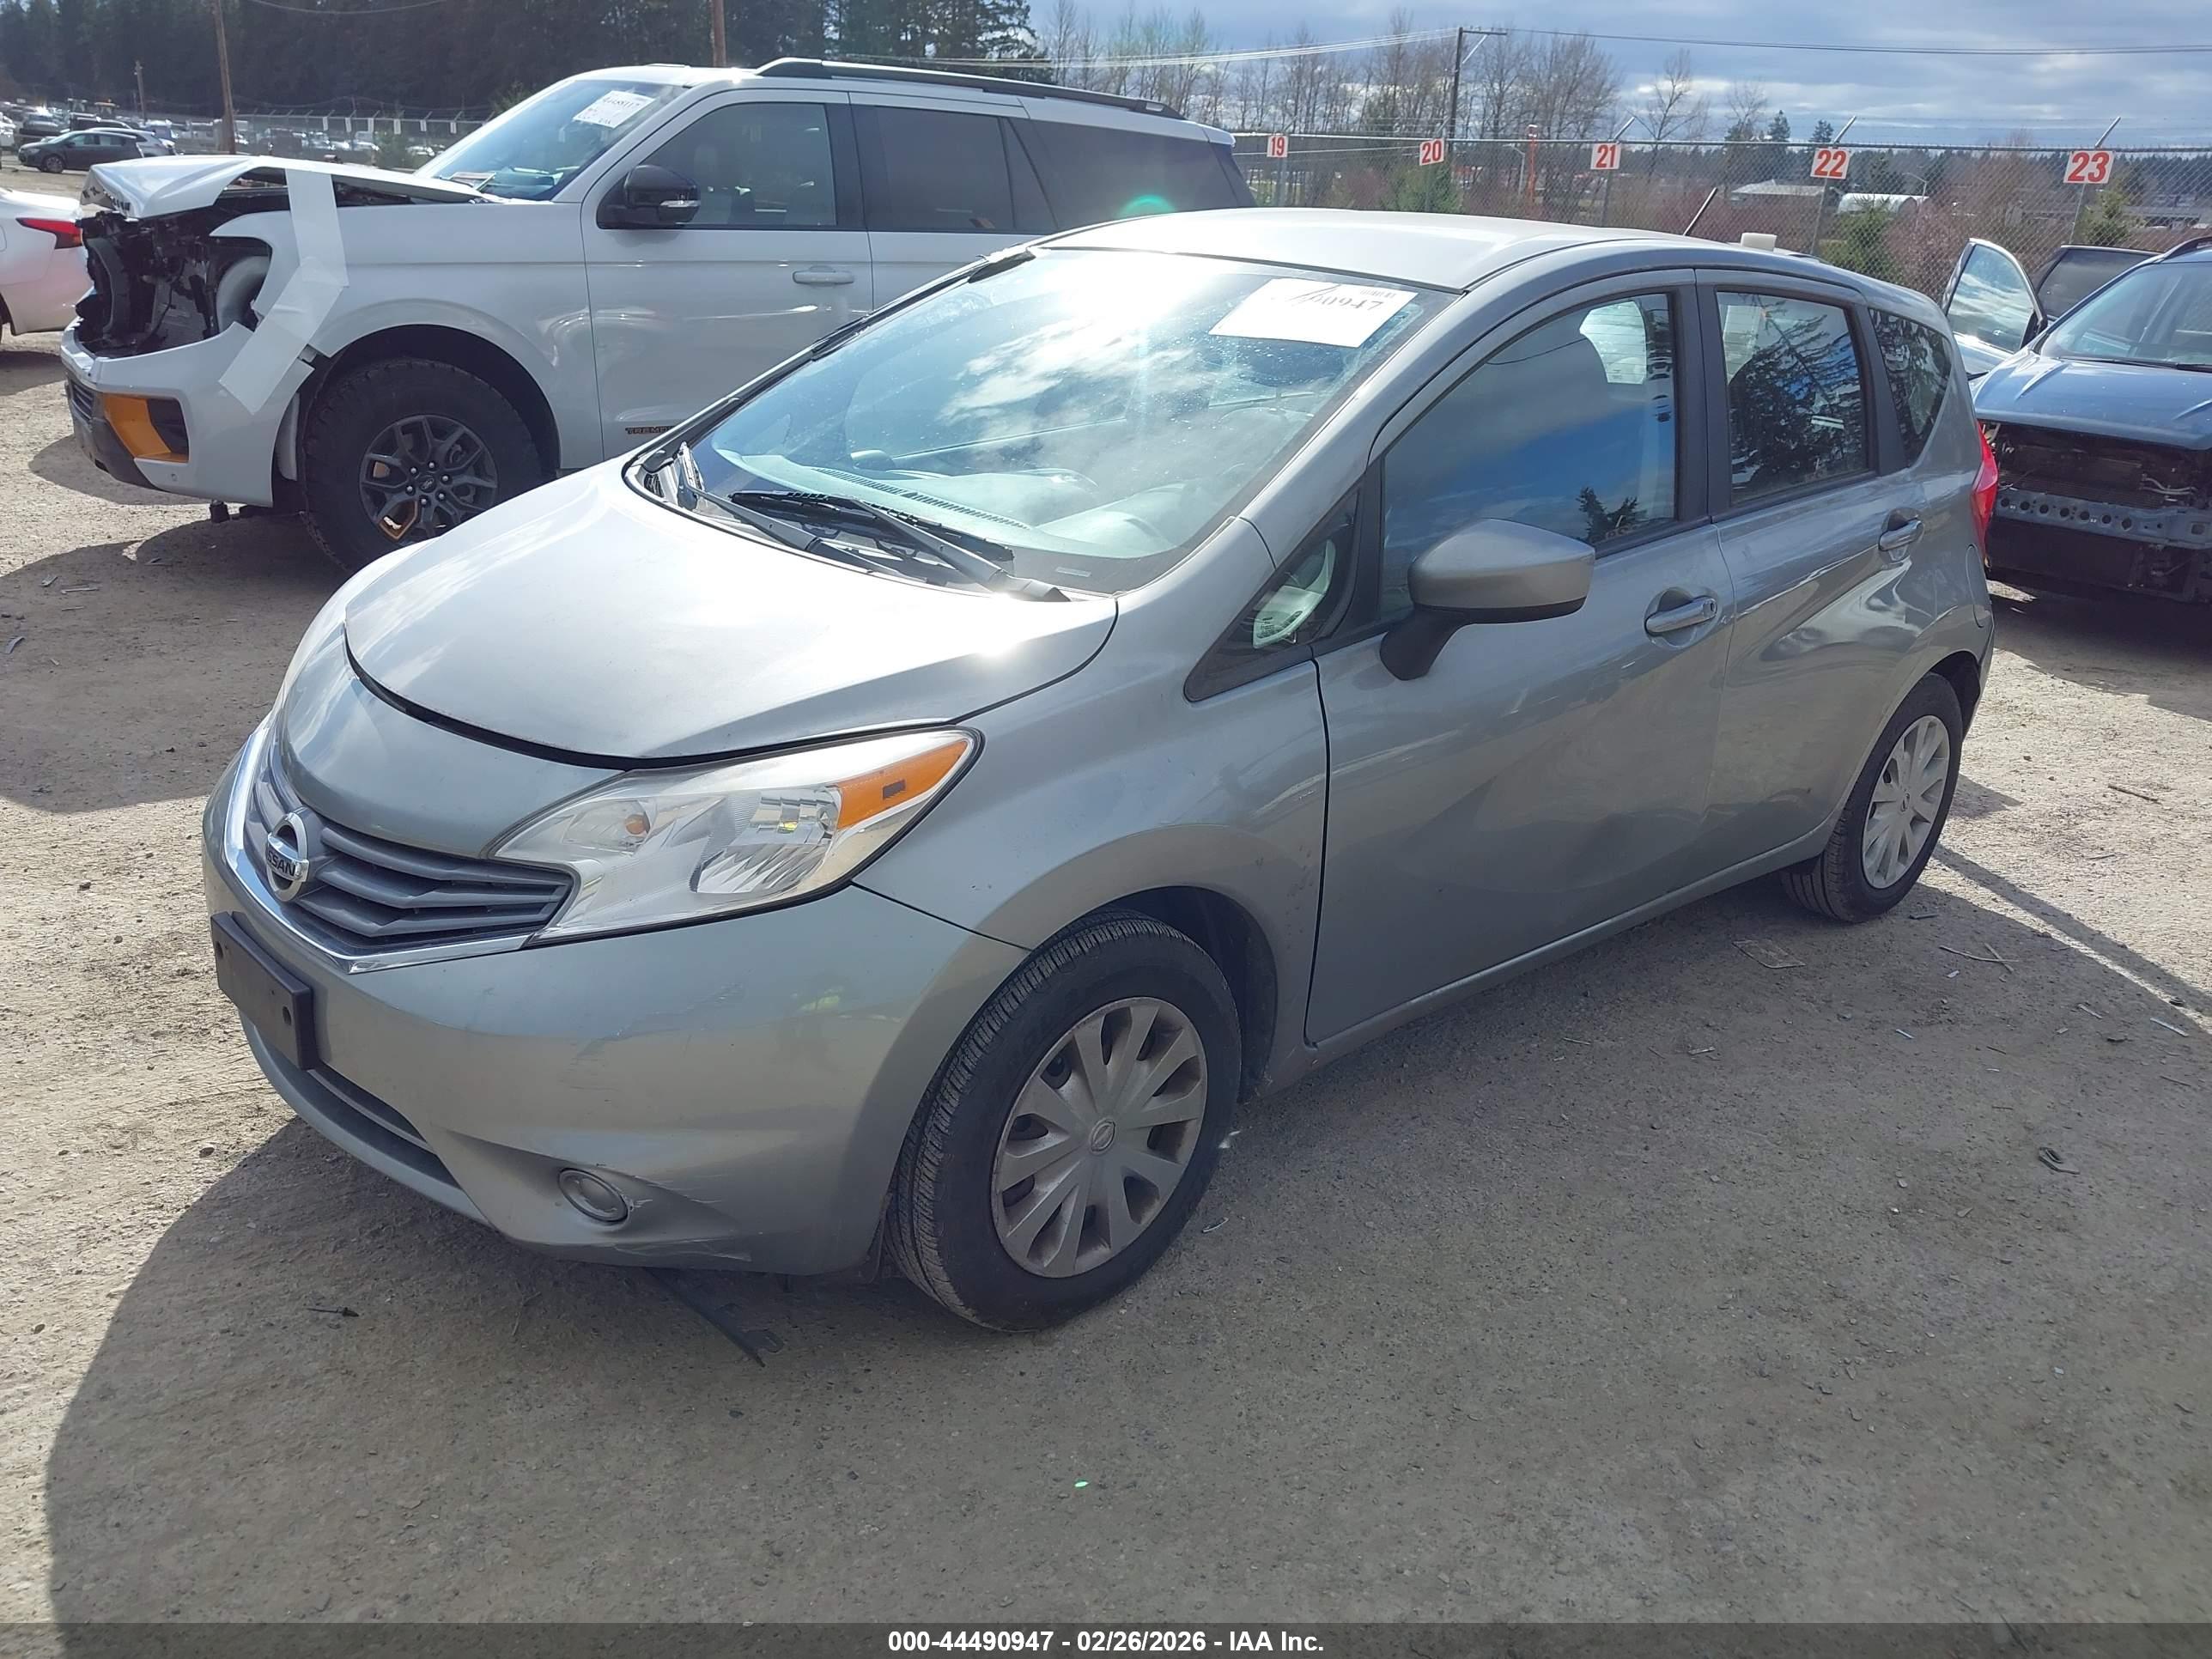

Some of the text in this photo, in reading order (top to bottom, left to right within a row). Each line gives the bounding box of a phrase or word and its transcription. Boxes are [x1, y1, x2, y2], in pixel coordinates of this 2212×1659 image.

[1271, 137, 1285, 155] 19
[1421, 140, 1442, 163] 20
[1595, 144, 1616, 168] 21
[1814, 149, 1847, 179] 22
[2066, 149, 2111, 184] 23
